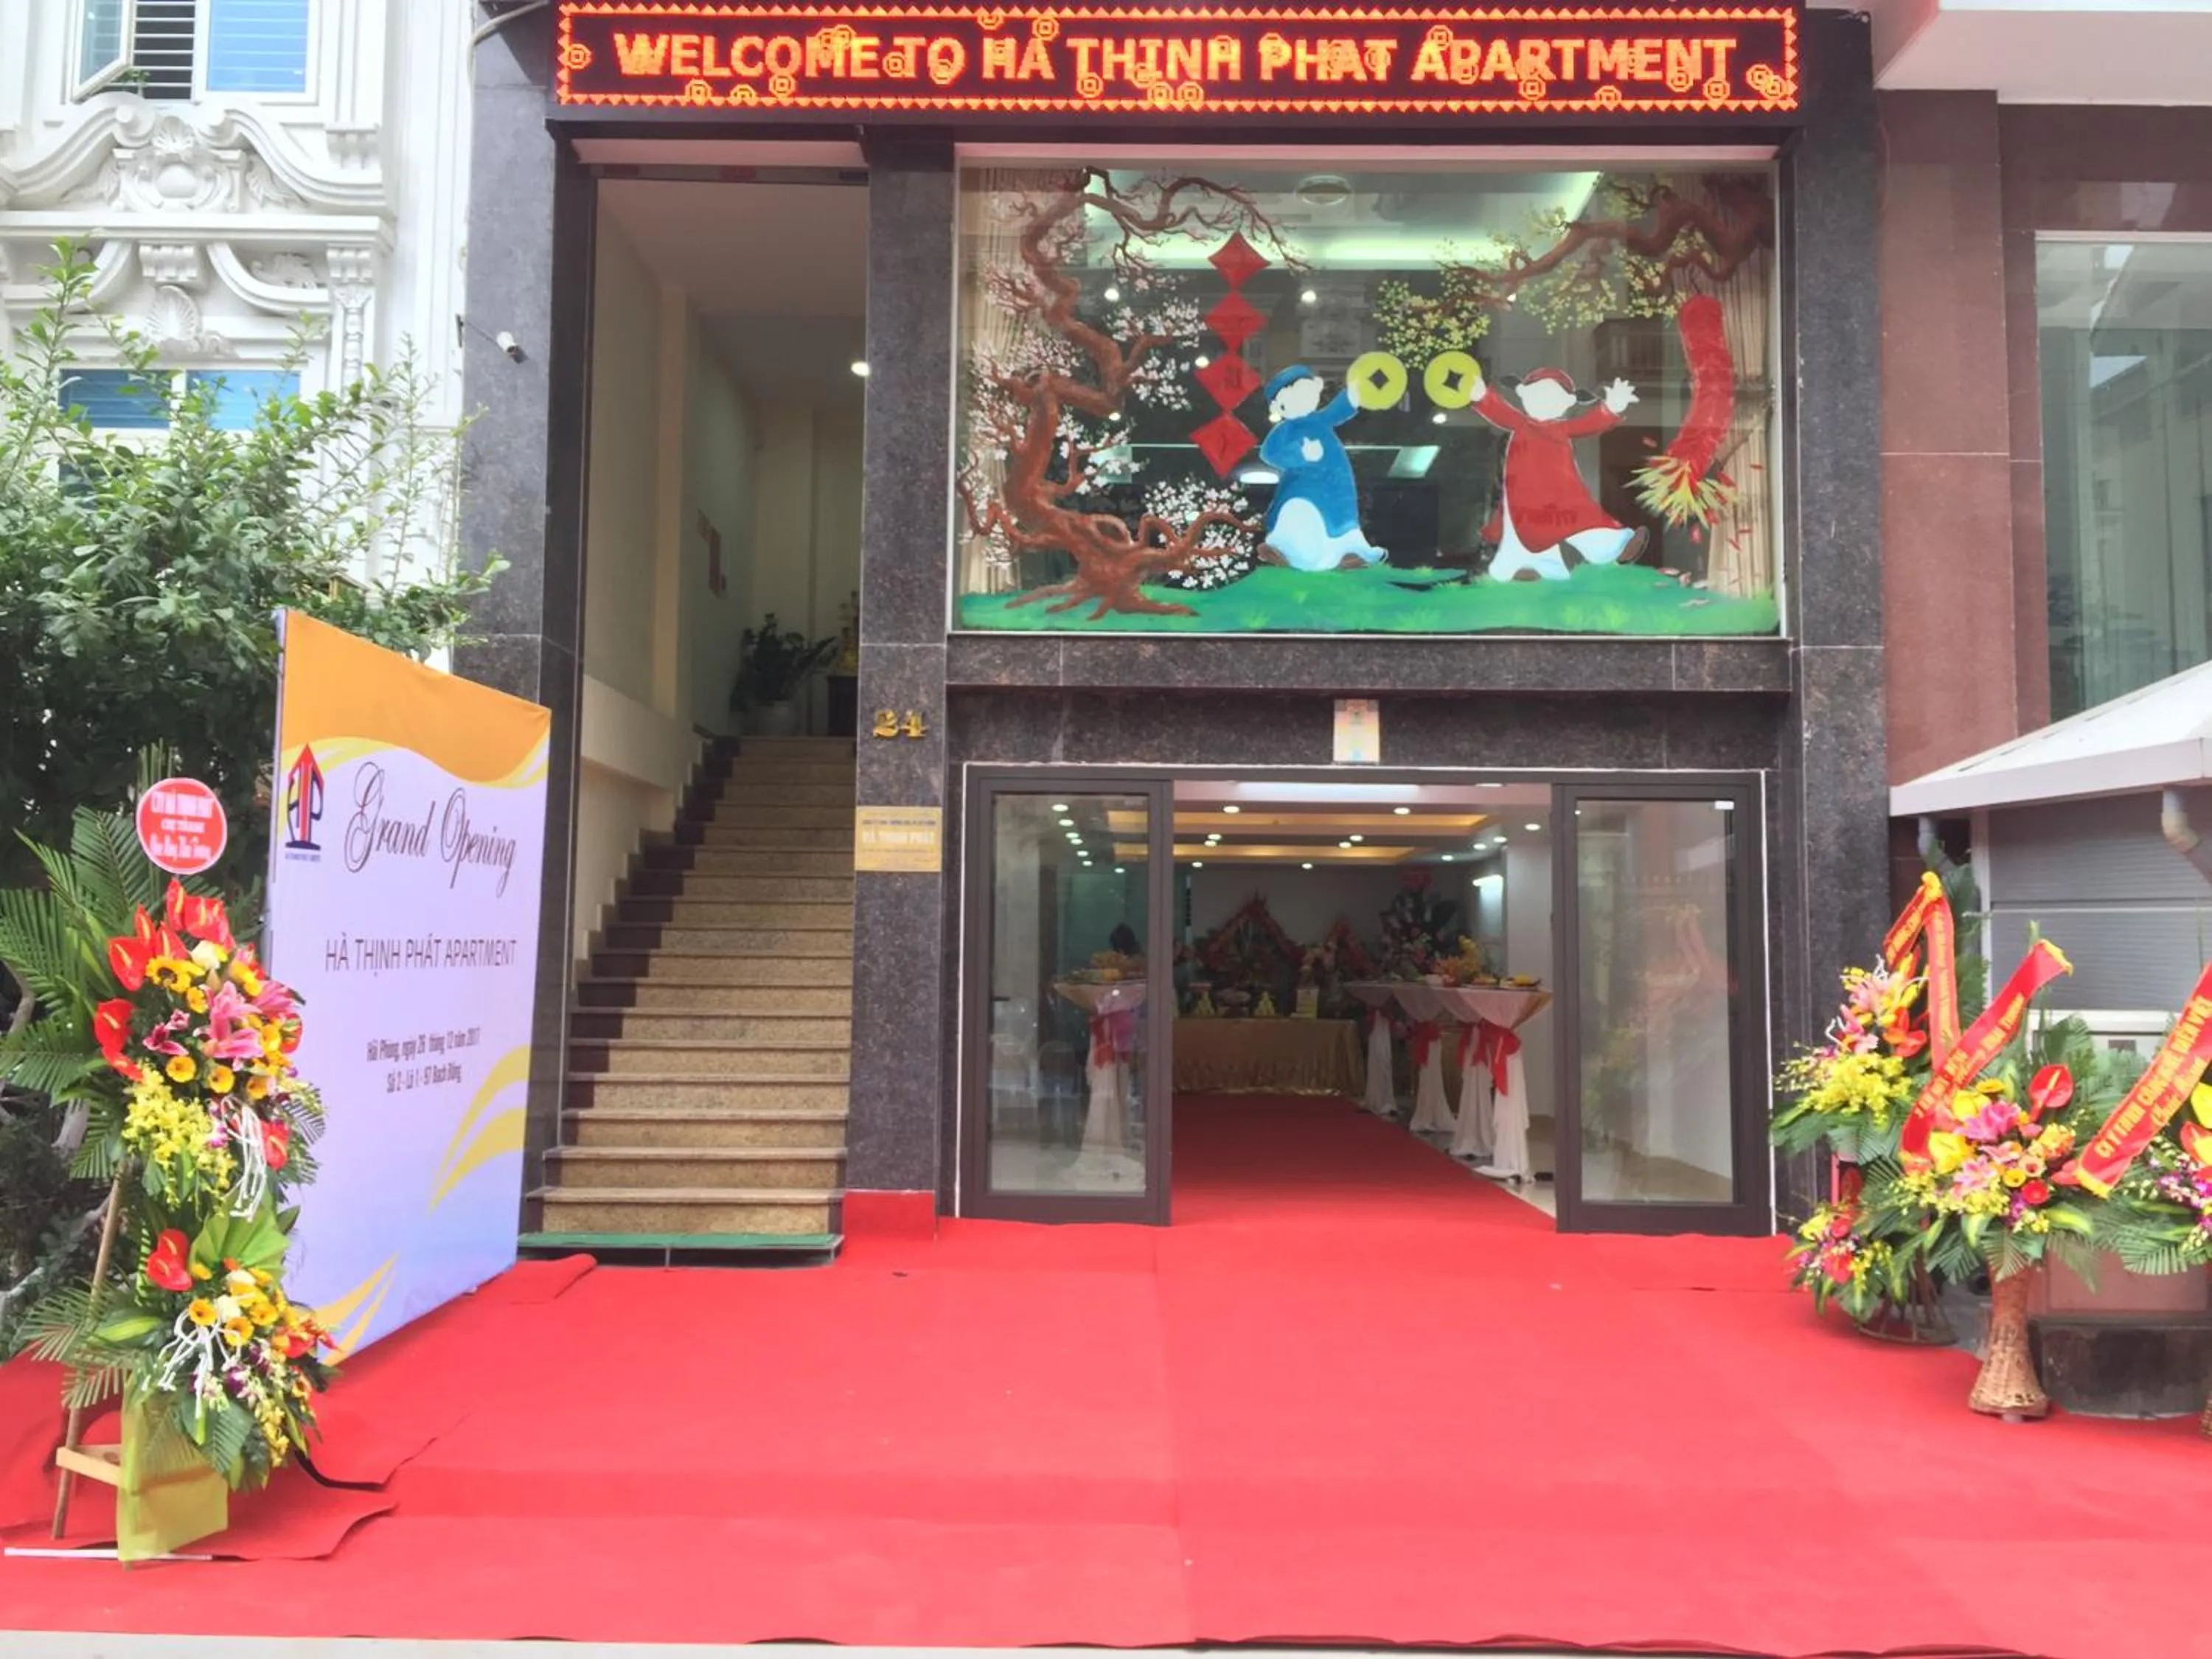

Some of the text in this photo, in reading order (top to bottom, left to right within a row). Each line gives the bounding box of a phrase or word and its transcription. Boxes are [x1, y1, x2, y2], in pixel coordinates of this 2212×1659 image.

[613, 32, 1737, 82] WELCOME TO HA THINH PHAT APARTMENT
[344, 761, 516, 899] Grand Opening
[325, 931, 517, 977] HÀ THỊNH PHÁT APARTMENT
